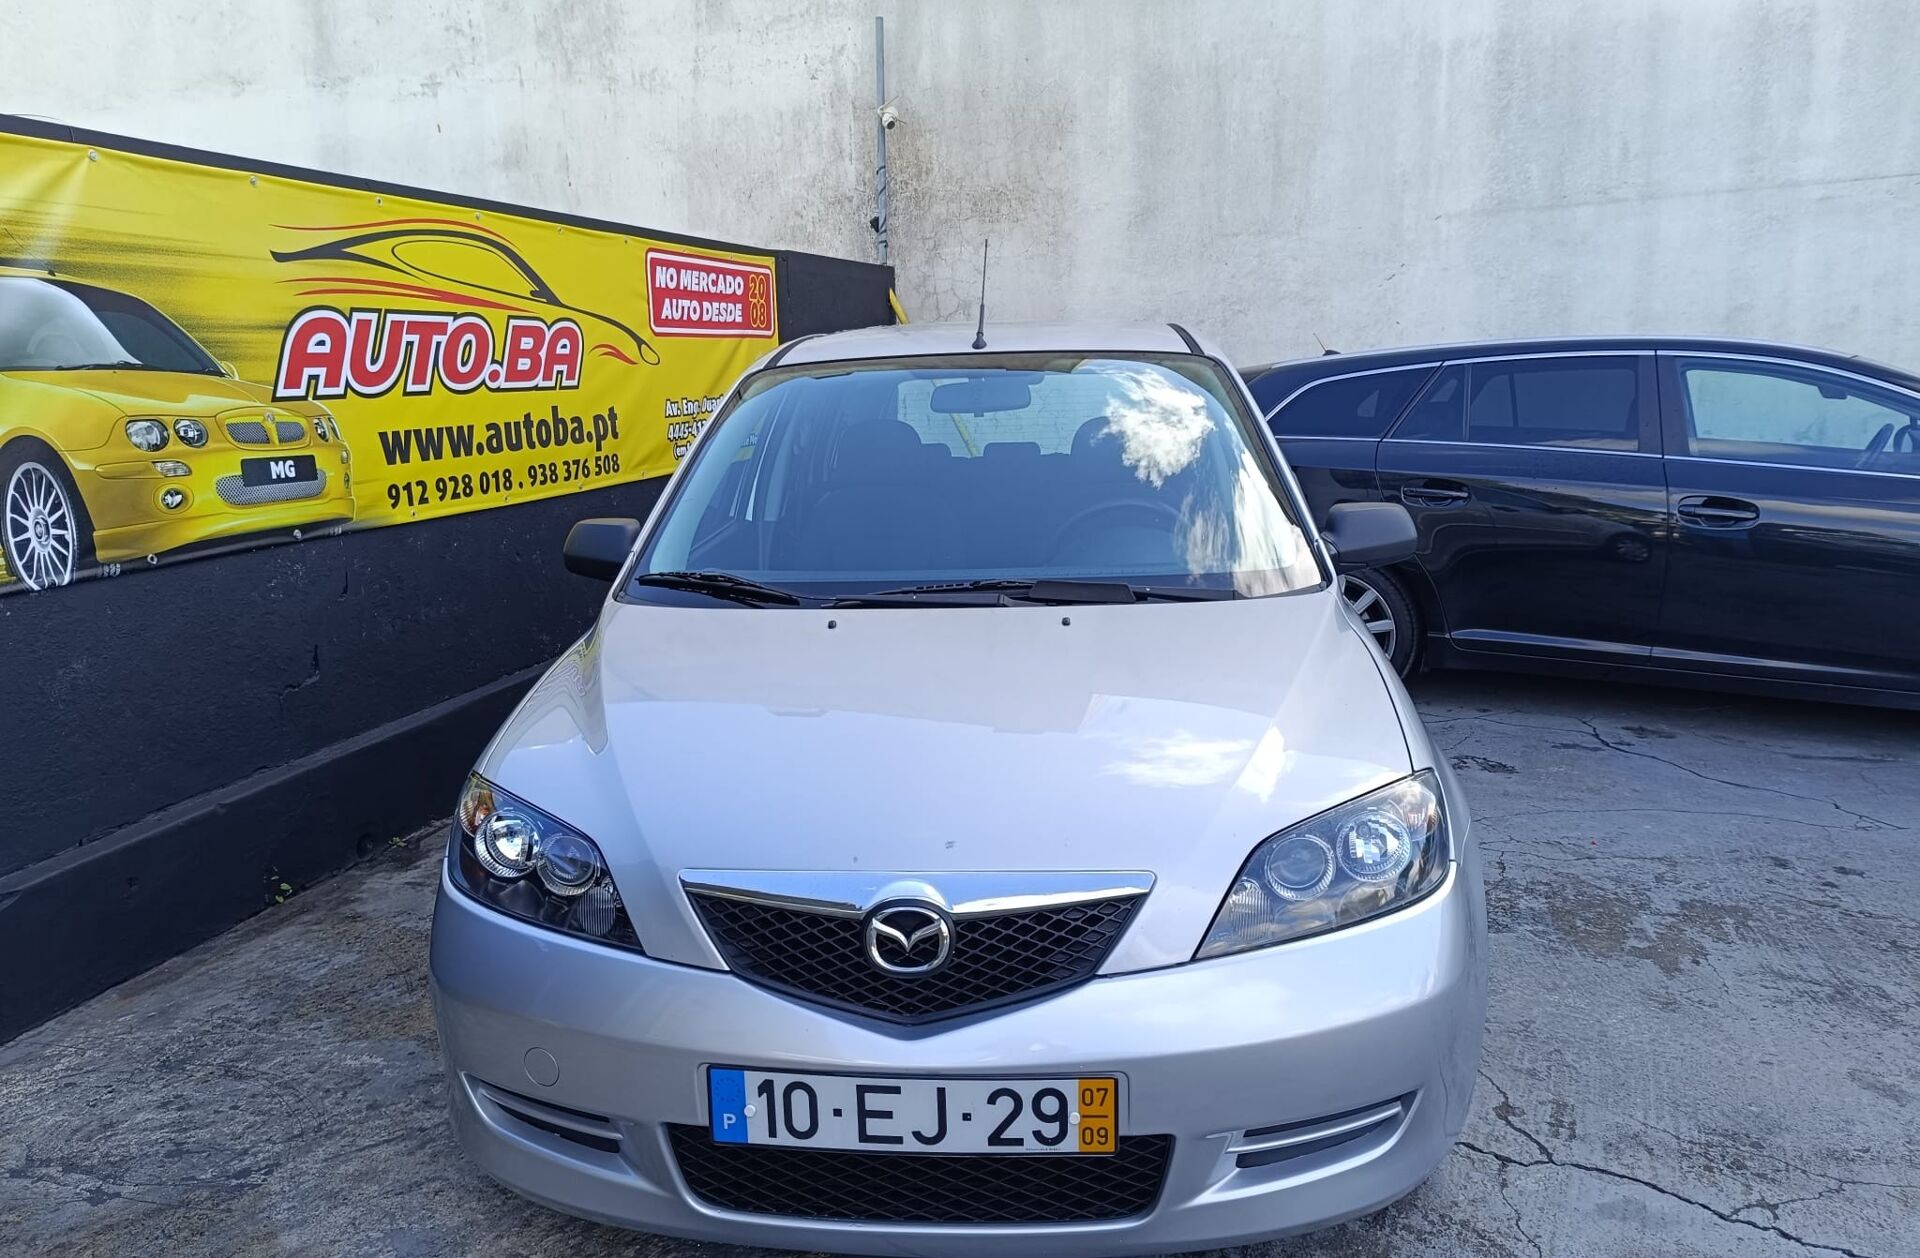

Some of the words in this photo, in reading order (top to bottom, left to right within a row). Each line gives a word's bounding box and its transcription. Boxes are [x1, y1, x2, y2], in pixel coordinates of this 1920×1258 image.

[655, 266, 677, 289] NO
[680, 269, 744, 295] MERCADO
[749, 274, 766, 302] 20
[661, 298, 700, 320] AUTO
[702, 302, 743, 323] DESDE
[750, 300, 767, 328] 08
[272, 305, 584, 401] AUTO.BA
[665, 398, 681, 418] Av.
[379, 405, 620, 466] www.autoba.pt
[270, 460, 296, 479] MG
[387, 480, 429, 509] 912
[436, 474, 473, 501] 928
[479, 469, 512, 495] 018
[528, 463, 559, 487] 938
[563, 458, 590, 482] 376
[595, 453, 620, 476] 508
[1081, 1088, 1109, 1107] 07
[723, 1113, 736, 1130] P
[1081, 1126, 1109, 1146] 09
